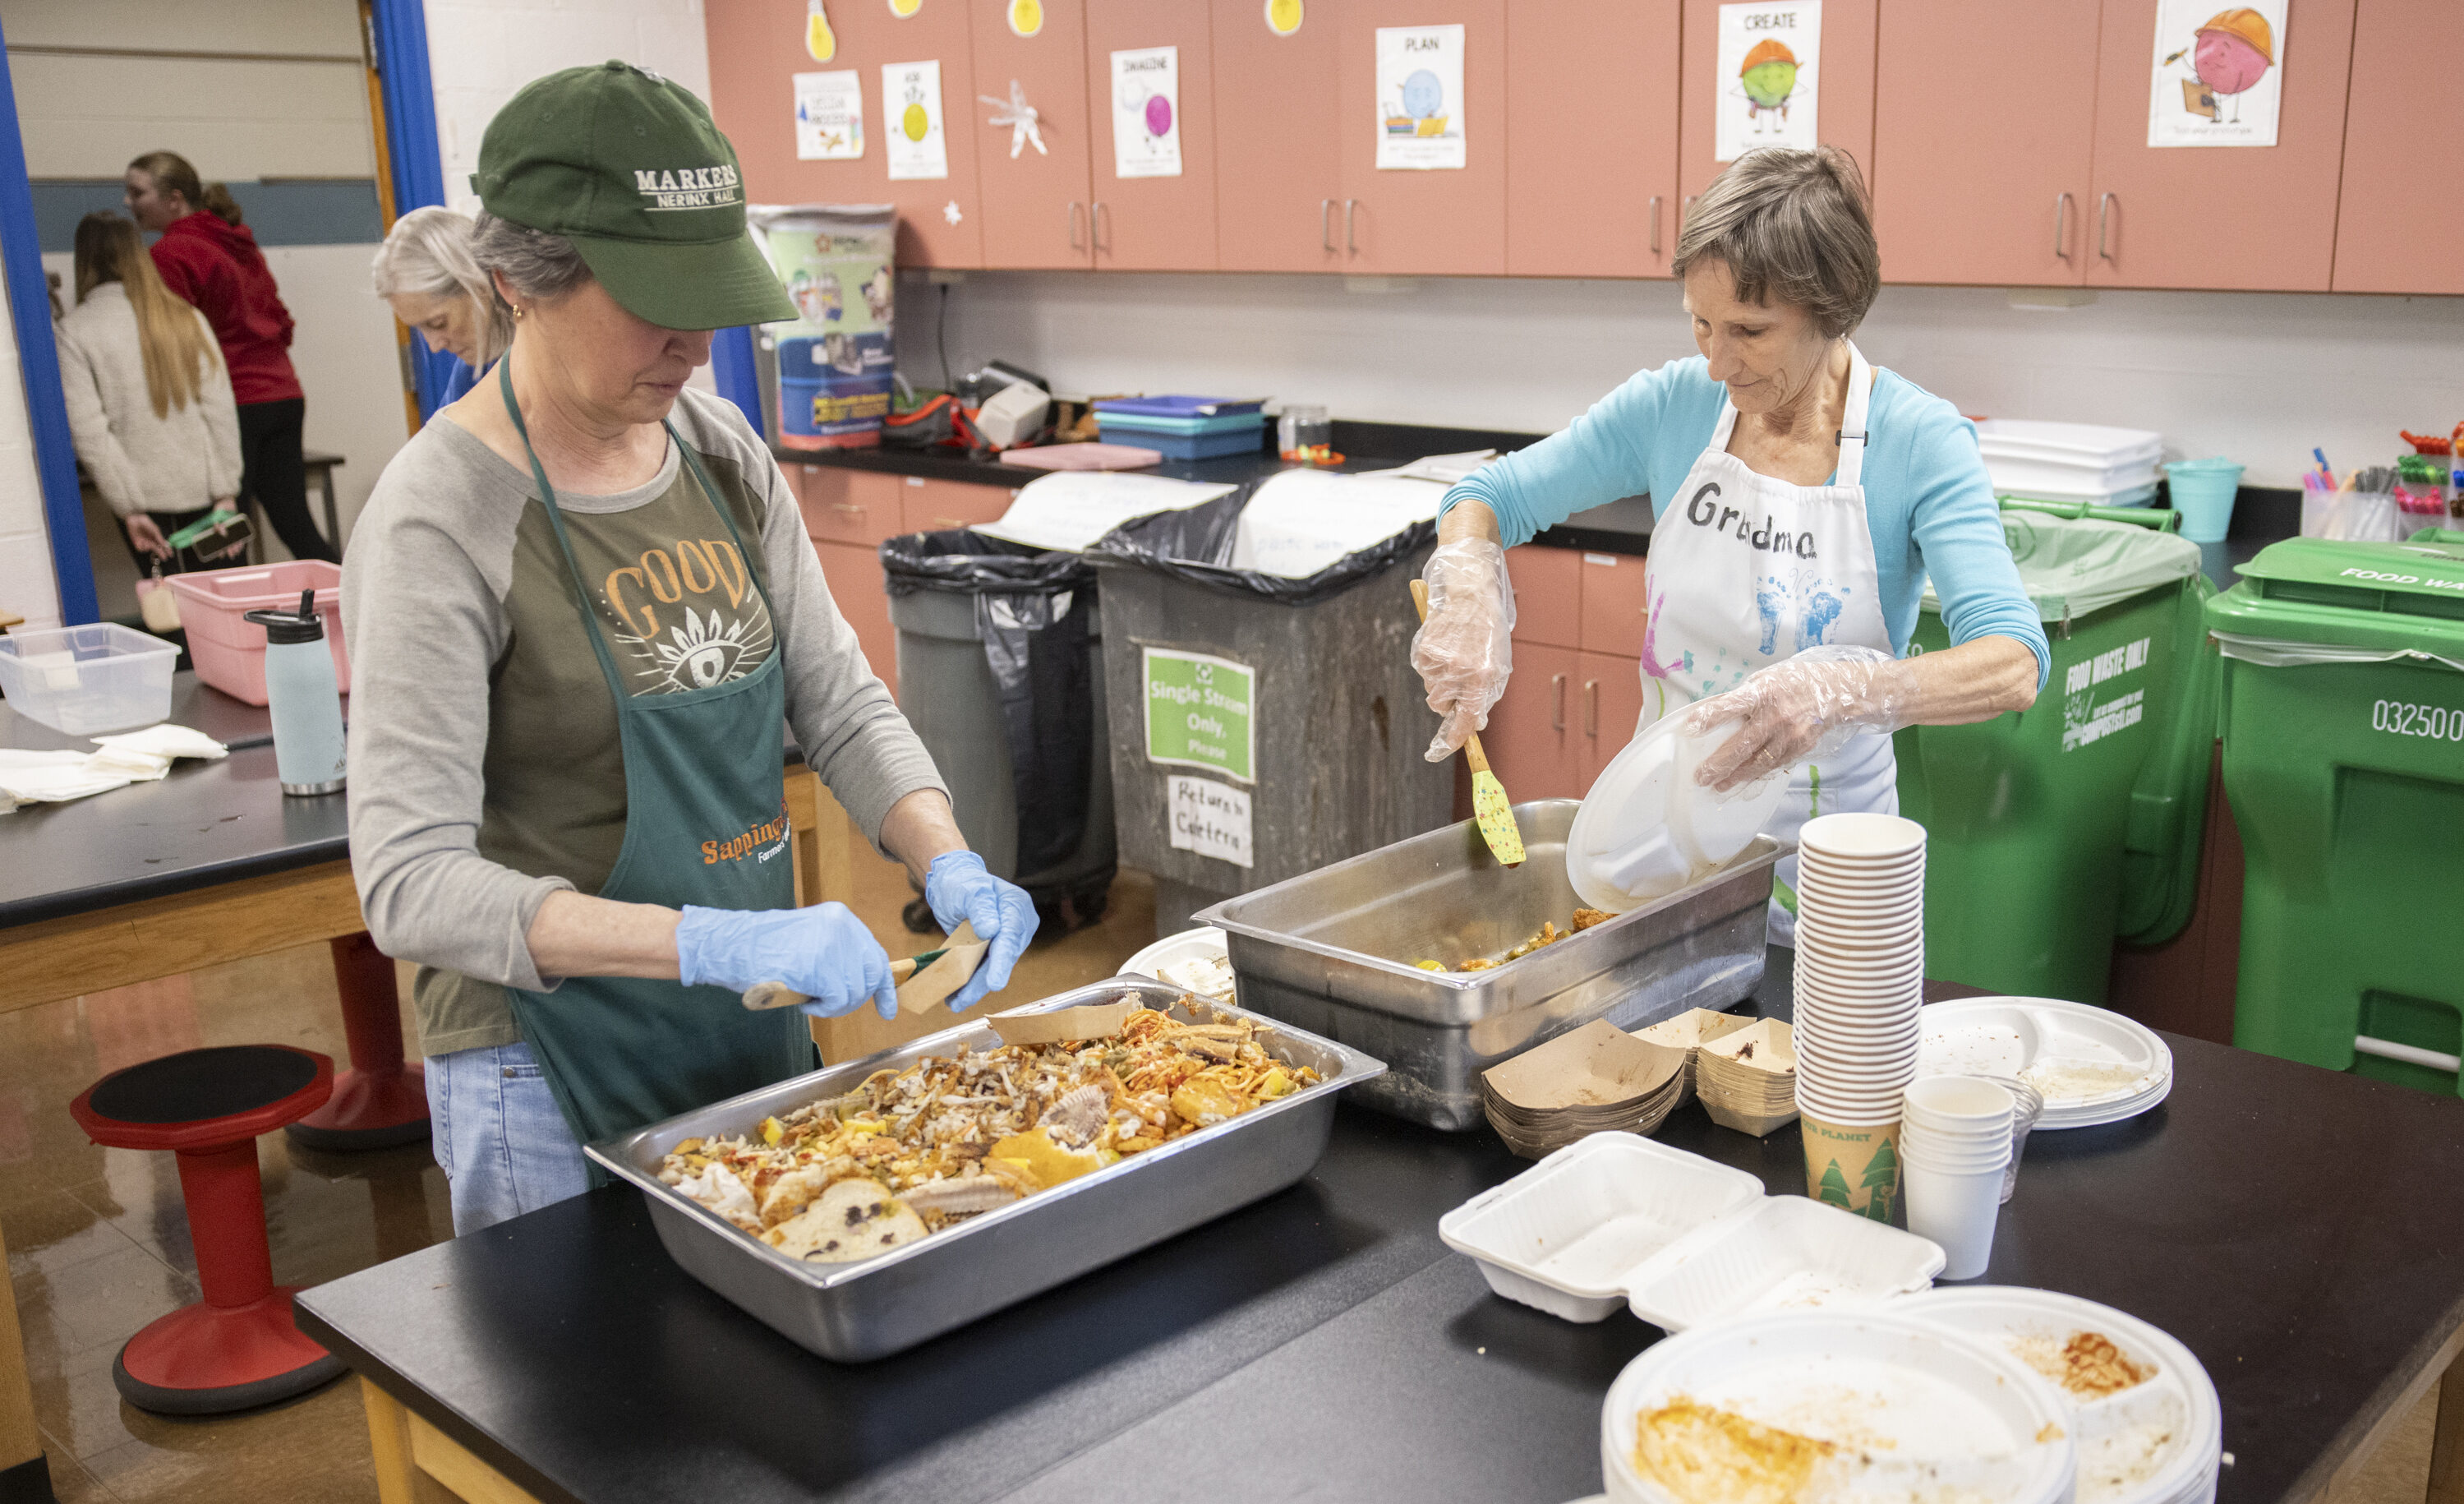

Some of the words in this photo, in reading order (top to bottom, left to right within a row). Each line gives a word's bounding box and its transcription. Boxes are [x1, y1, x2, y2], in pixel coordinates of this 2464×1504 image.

[1744, 12, 1797, 30] CREATE
[1405, 37, 1439, 51] PLAN
[657, 191, 710, 207] NERINX
[714, 188, 736, 205] HALL
[2340, 568, 2419, 584] FOOD
[606, 538, 745, 639] GOOD
[2066, 660, 2091, 696] FOOD
[2093, 647, 2125, 685] WASTE
[2125, 637, 2150, 671] ONLY
[1150, 680, 1201, 705] Single
[1821, 1128, 1872, 1142] PLANET
